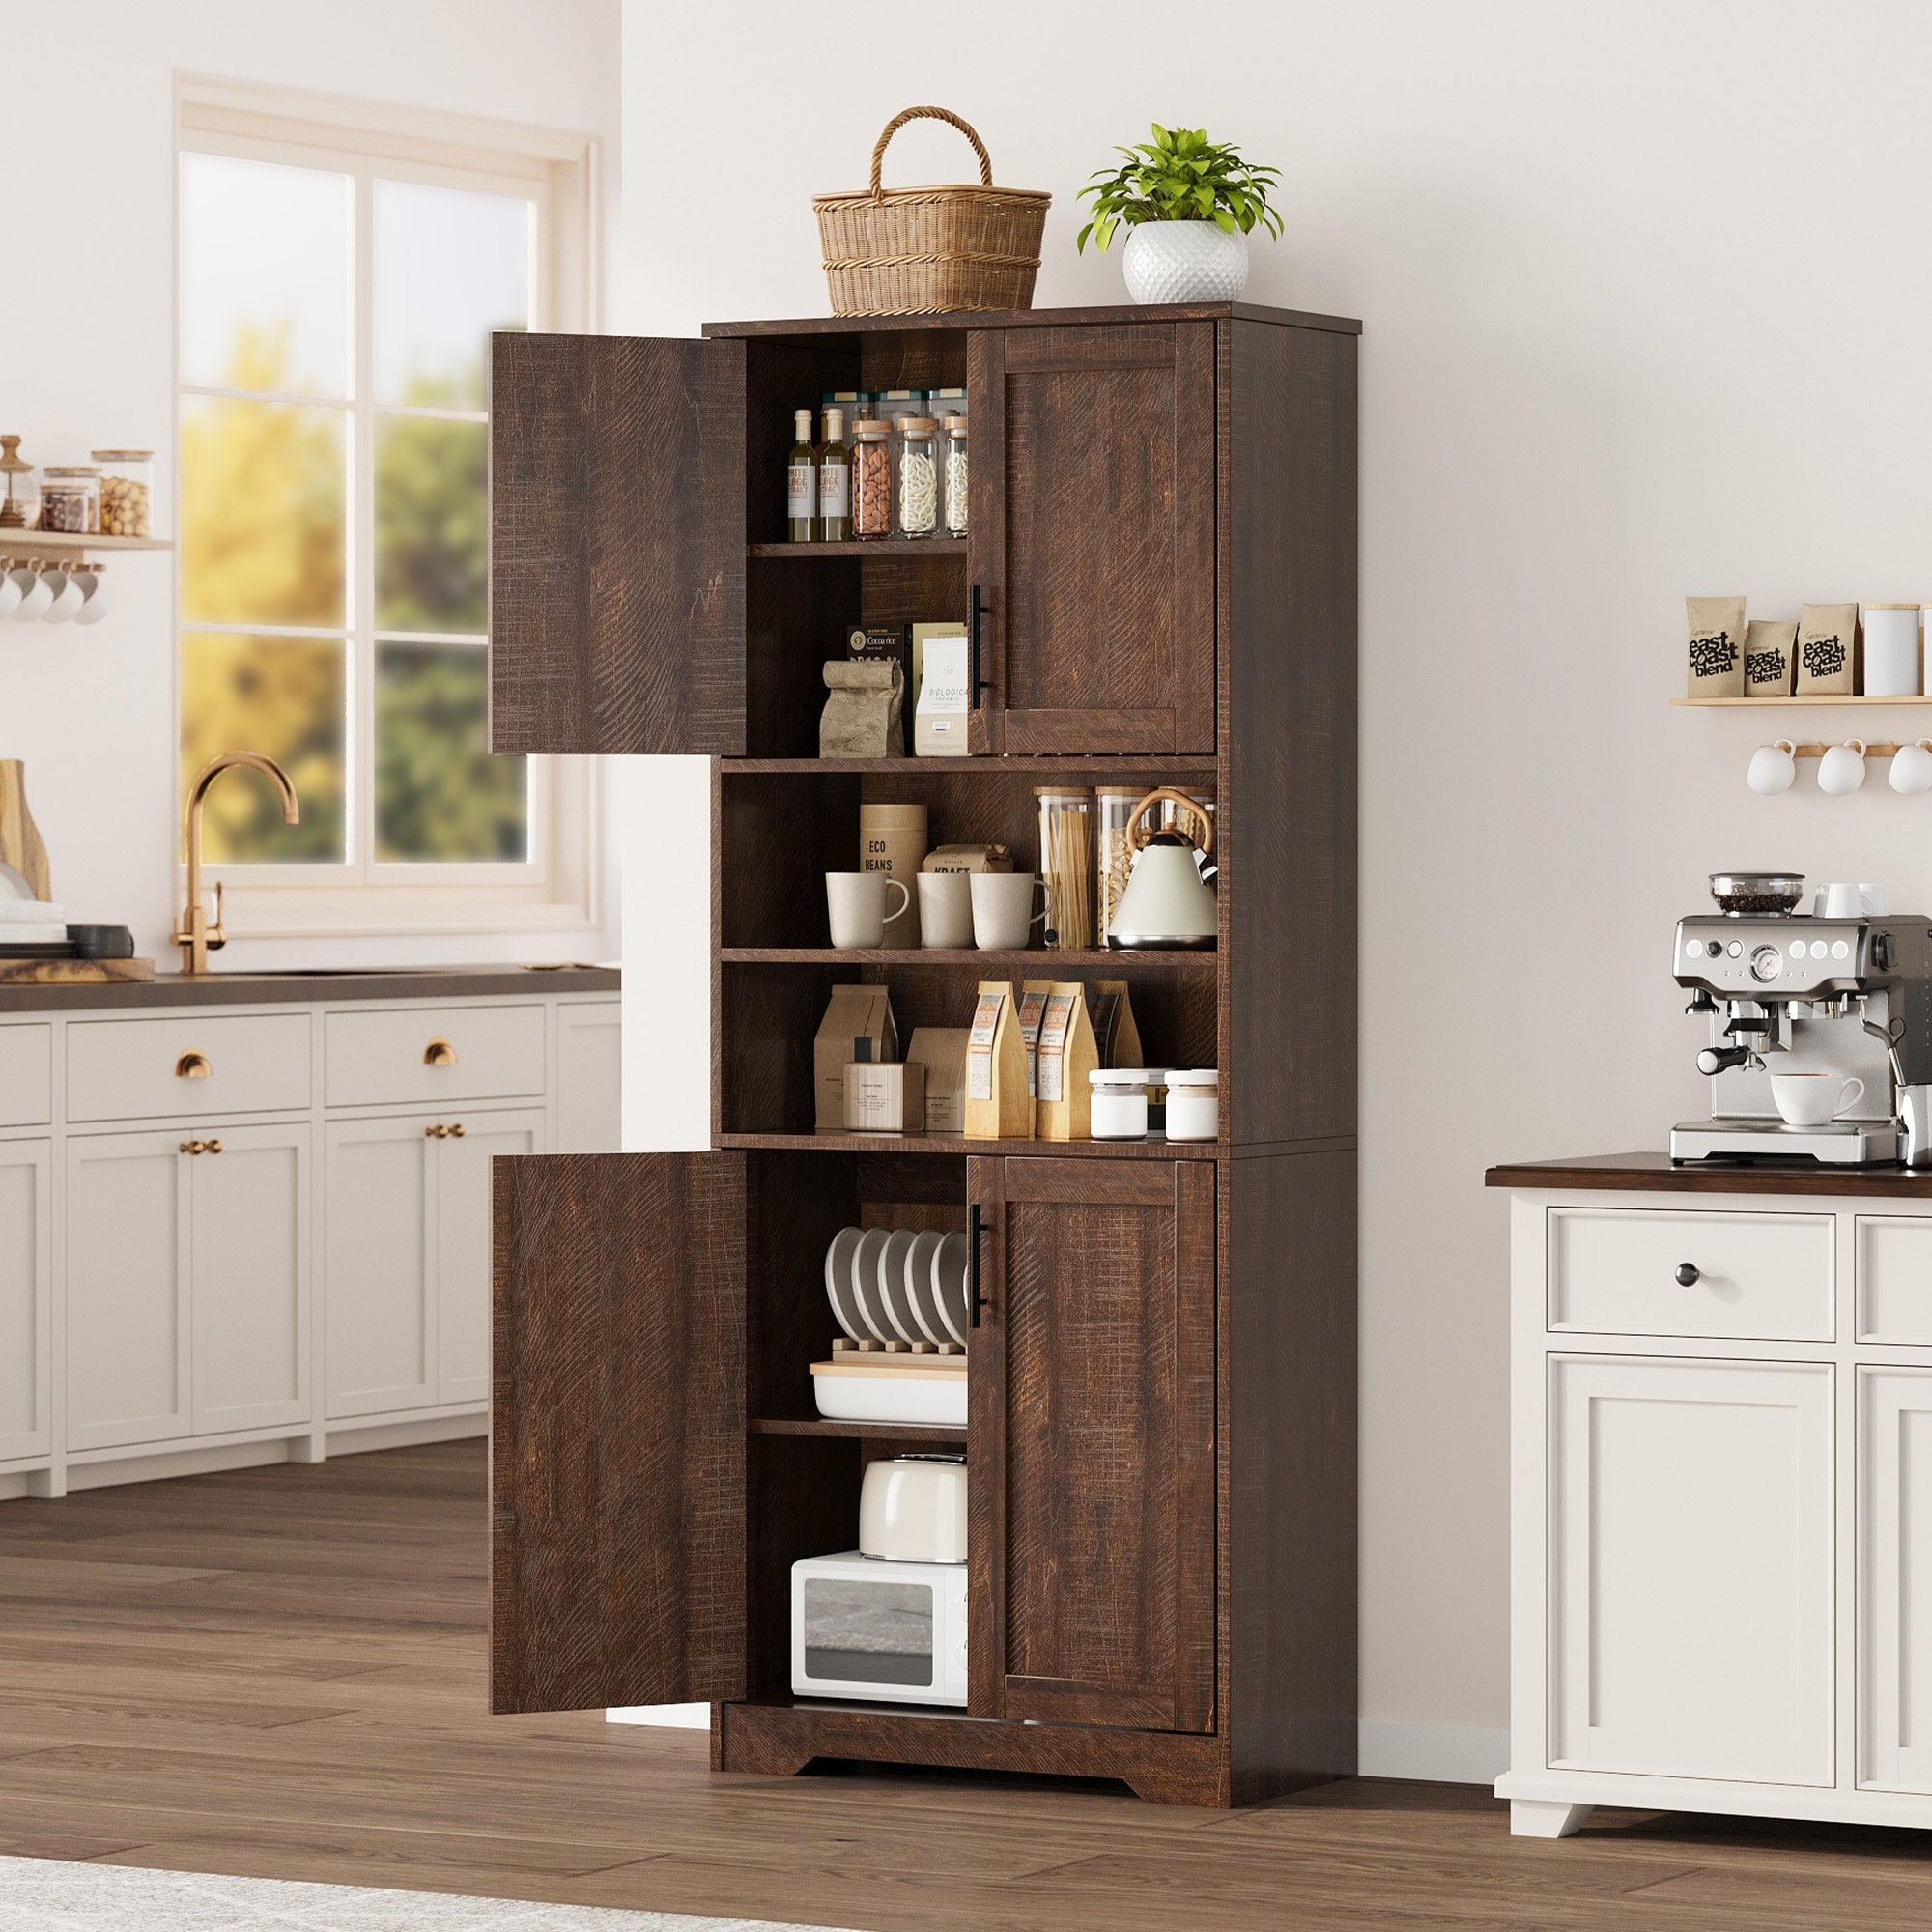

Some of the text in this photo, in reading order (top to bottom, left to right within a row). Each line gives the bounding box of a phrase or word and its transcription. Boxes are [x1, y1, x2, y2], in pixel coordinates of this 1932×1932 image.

[867, 636, 896, 645] Cocoa rice
[1690, 631, 1728, 654] east
[1804, 634, 1840, 656] east
[1690, 642, 1739, 668] coast
[1747, 647, 1780, 666] east
[1803, 645, 1846, 668] coast
[1695, 658, 1734, 677] blend
[1746, 657, 1786, 675] coast
[1811, 661, 1842, 678] blend
[1752, 668, 1782, 683] blend
[869, 839, 886, 853] ECO
[866, 859, 893, 871] BEANS
